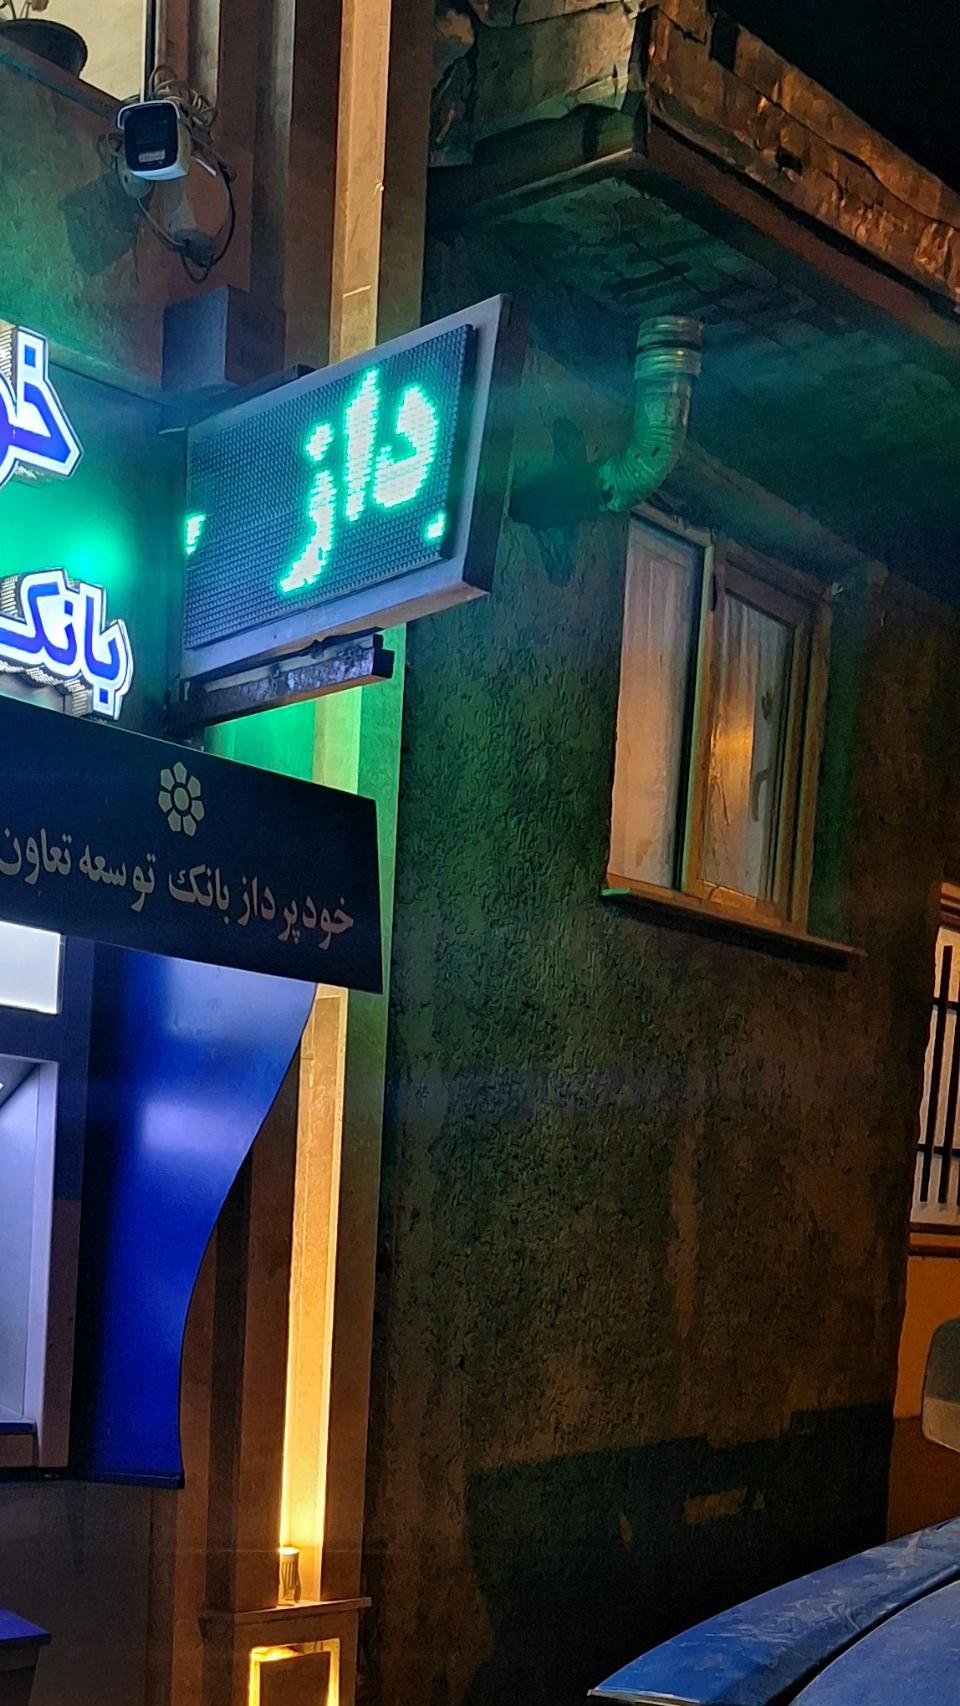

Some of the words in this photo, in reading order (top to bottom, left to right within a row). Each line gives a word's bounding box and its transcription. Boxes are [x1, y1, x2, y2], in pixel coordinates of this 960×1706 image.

[279, 366, 446, 594] داز
[78, 844, 157, 913] توسعه
[168, 864, 231, 926] بانک
